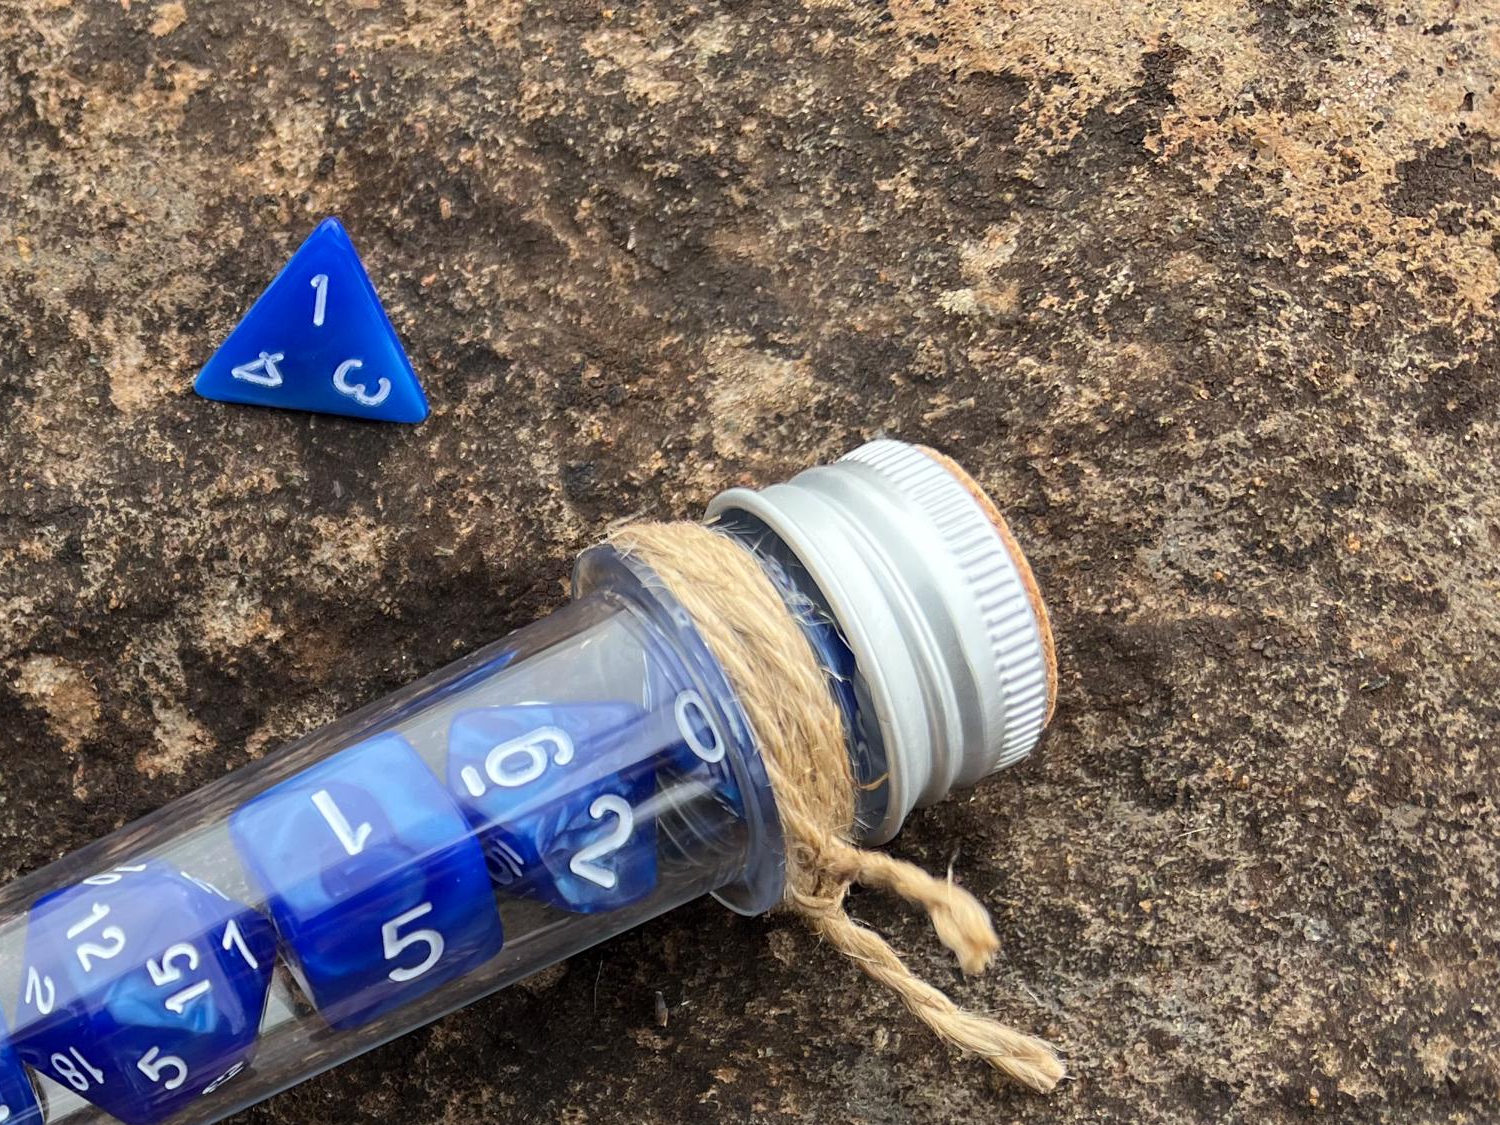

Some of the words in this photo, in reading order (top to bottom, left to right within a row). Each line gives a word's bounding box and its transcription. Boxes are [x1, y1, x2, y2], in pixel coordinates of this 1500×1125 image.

[310, 274, 329, 327] 1
[231, 351, 284, 387] 4
[333, 359, 392, 406] 3
[311, 790, 372, 856] 1
[570, 794, 633, 889] 2
[66, 902, 126, 973] 12
[382, 902, 445, 982] 5
[25, 966, 55, 1015] 2
[146, 942, 211, 1014] 15
[51, 1046, 104, 1092] 18
[137, 1046, 188, 1090] 5
